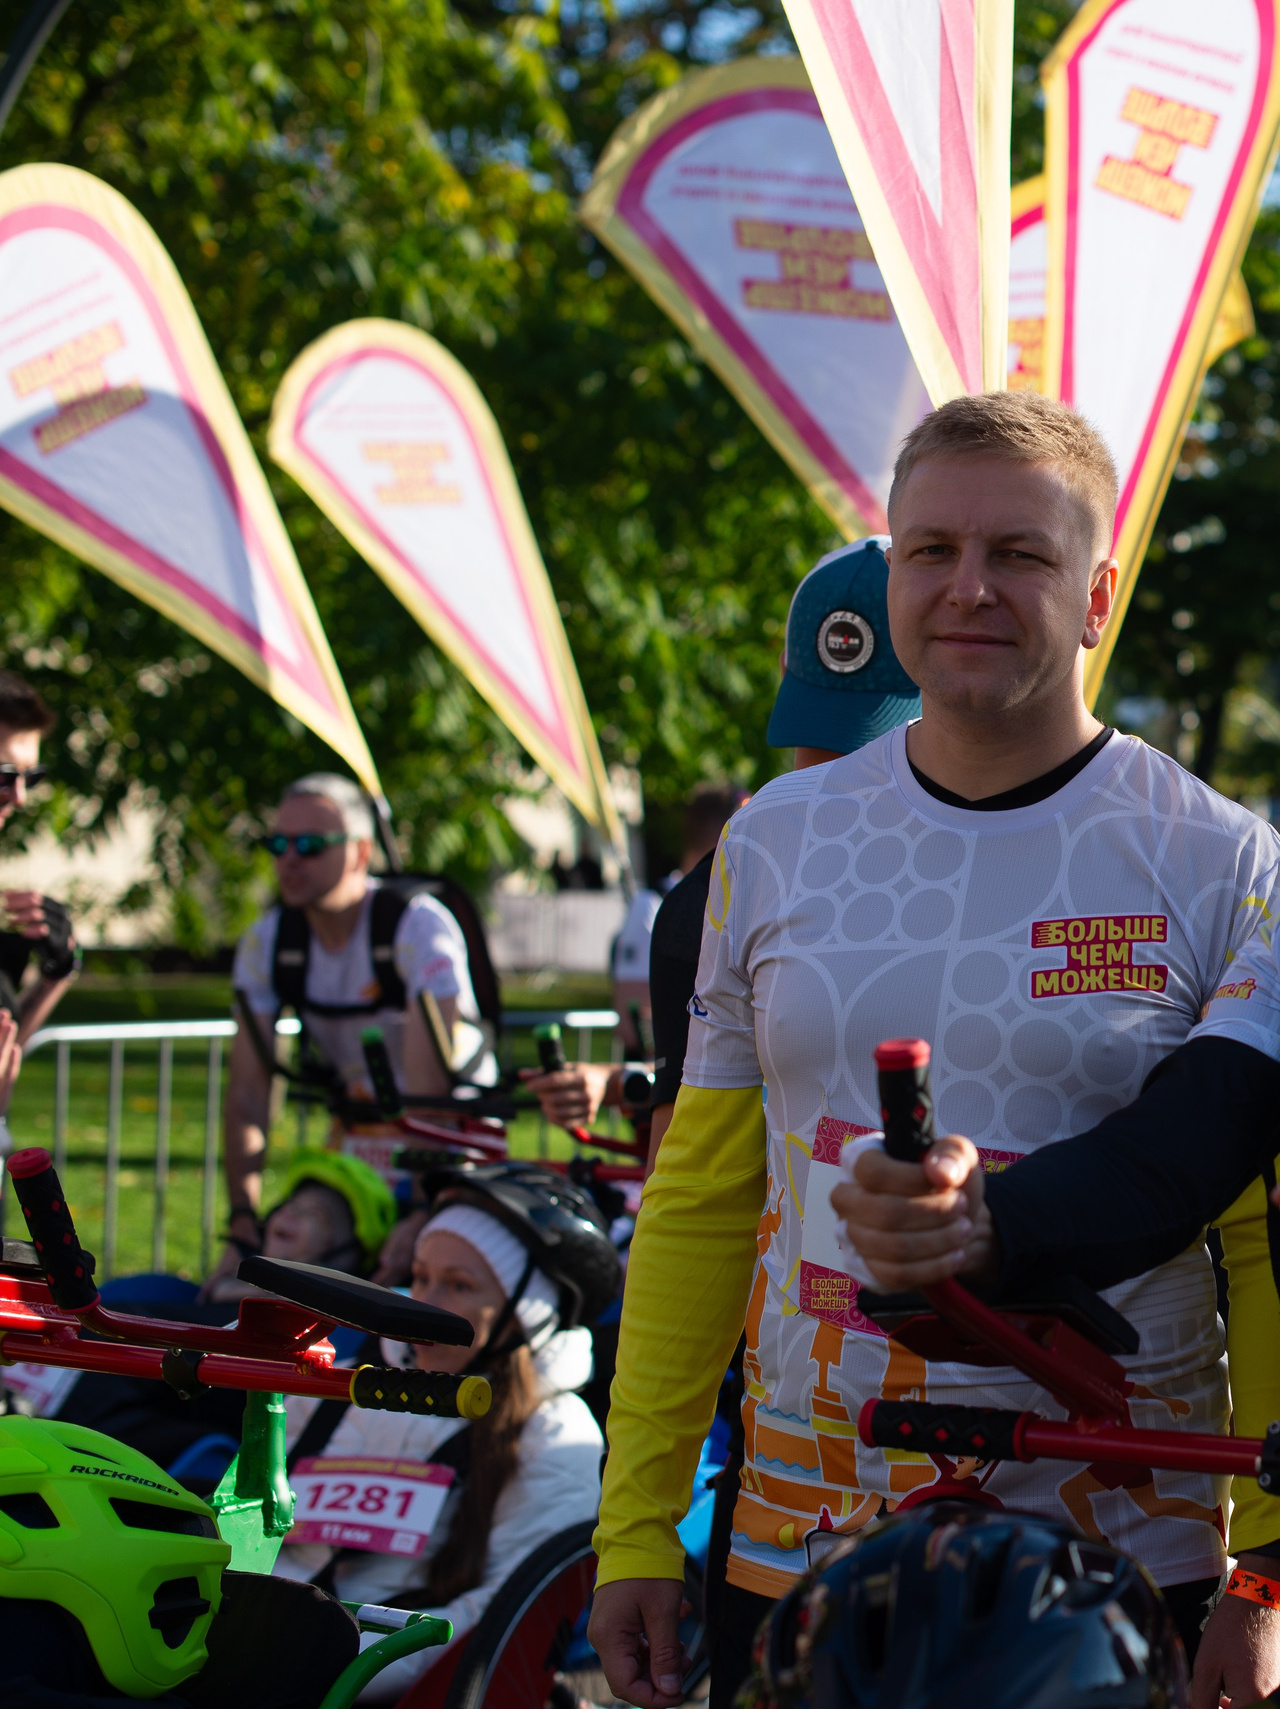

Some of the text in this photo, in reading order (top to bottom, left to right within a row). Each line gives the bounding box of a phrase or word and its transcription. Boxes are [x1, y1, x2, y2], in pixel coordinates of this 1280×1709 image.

[1035, 917, 1165, 946] БОЛЬШЕ
[1070, 941, 1129, 966] ЧЕМ
[1035, 967, 1164, 996] МОЖЕШЬ
[813, 1279, 849, 1289] БОЛЬШЕ
[821, 1289, 838, 1298] ЧЕМ
[812, 1299, 848, 1308] МОЖЕШЬ
[70, 1465, 180, 1496] ROCKRIDER
[308, 1483, 416, 1519] 1281
